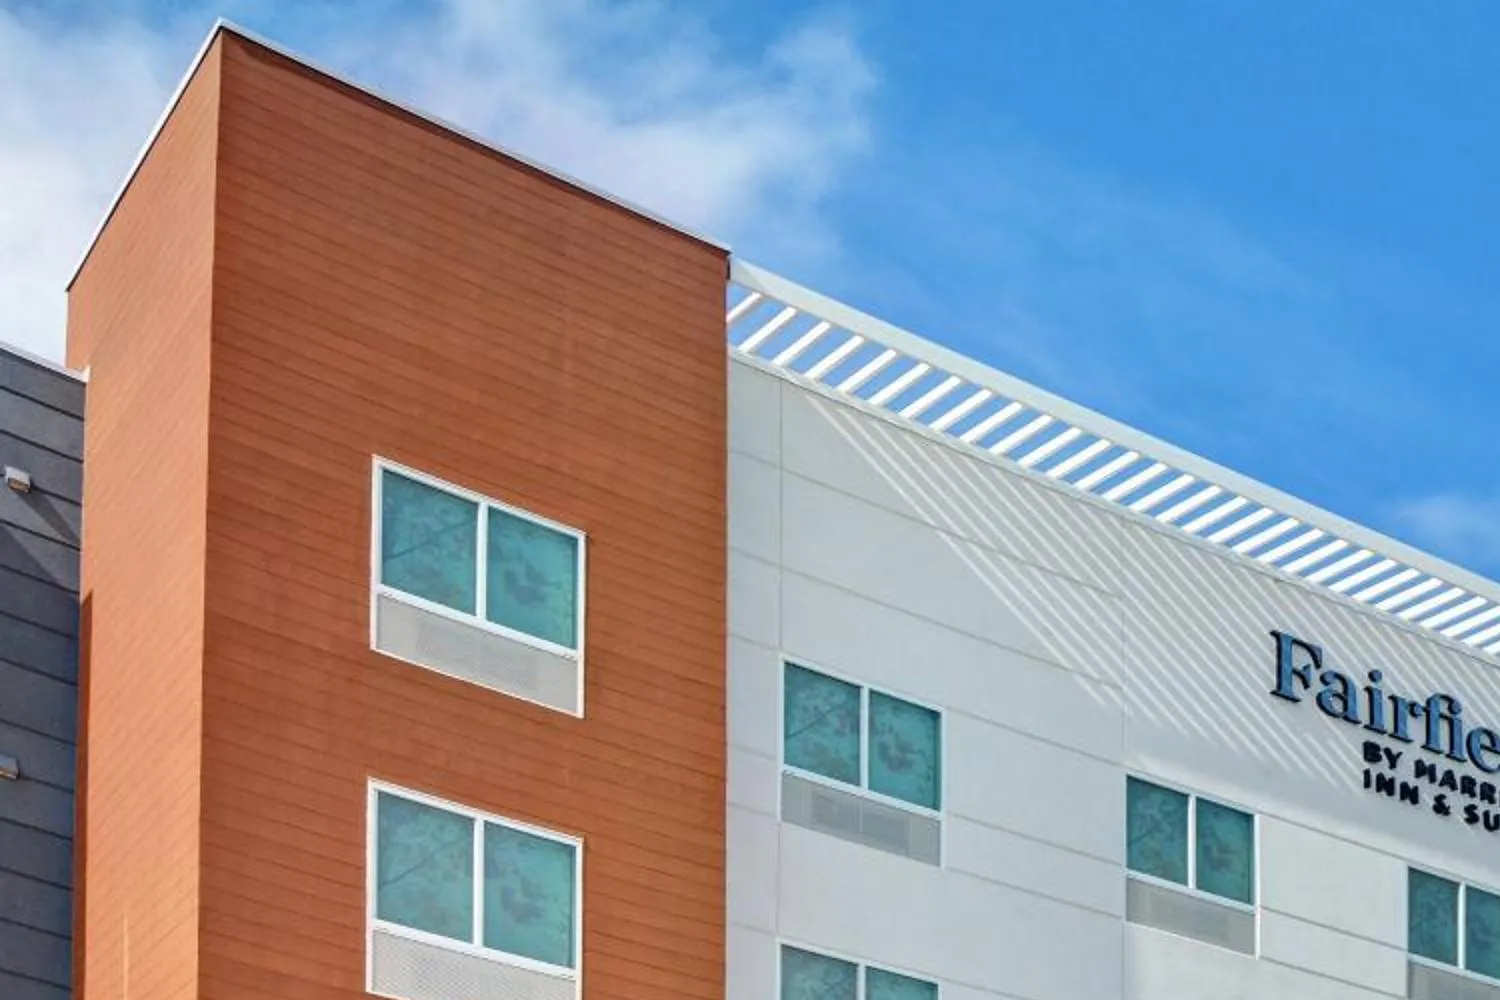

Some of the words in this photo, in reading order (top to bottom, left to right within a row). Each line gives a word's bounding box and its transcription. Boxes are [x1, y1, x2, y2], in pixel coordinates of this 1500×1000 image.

[1362, 740, 1402, 770] BY
[1362, 768, 1419, 805] INN
[1432, 793, 1451, 817] &
